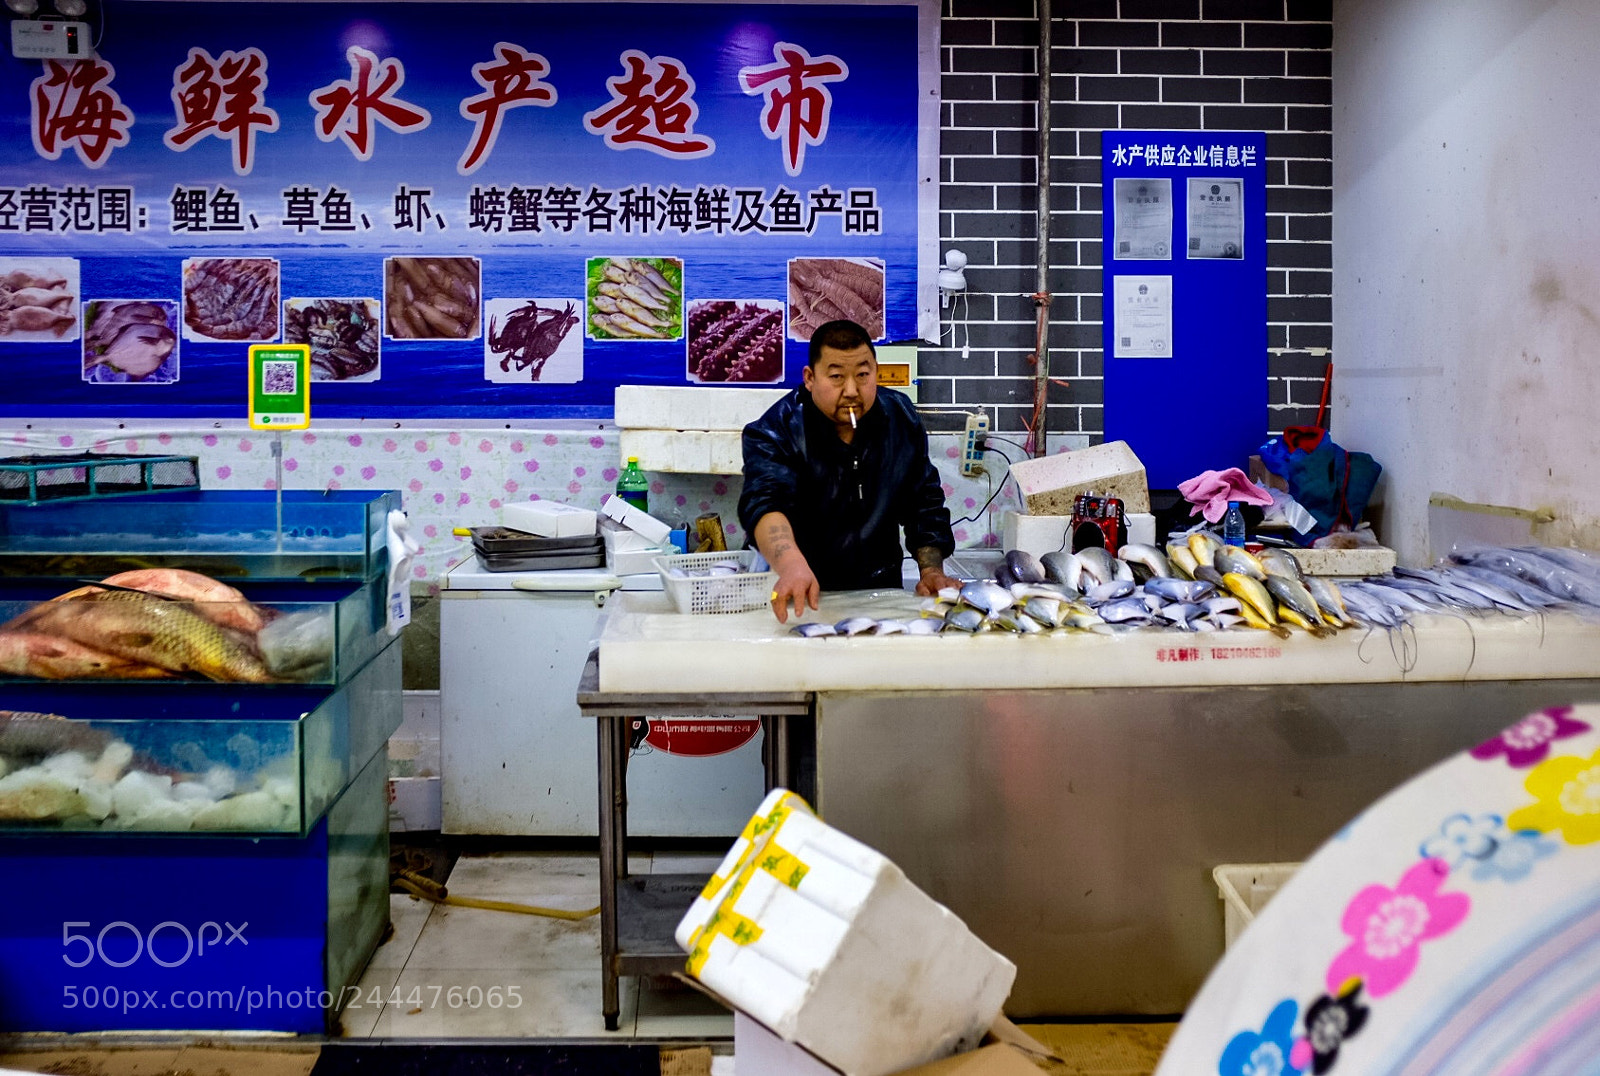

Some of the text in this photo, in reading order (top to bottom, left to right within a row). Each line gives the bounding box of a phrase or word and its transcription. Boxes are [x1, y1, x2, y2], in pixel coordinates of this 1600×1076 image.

[35, 46, 843, 171] 海鲜水产超市
[1111, 144, 1257, 168] 水产供应企业信息栏
